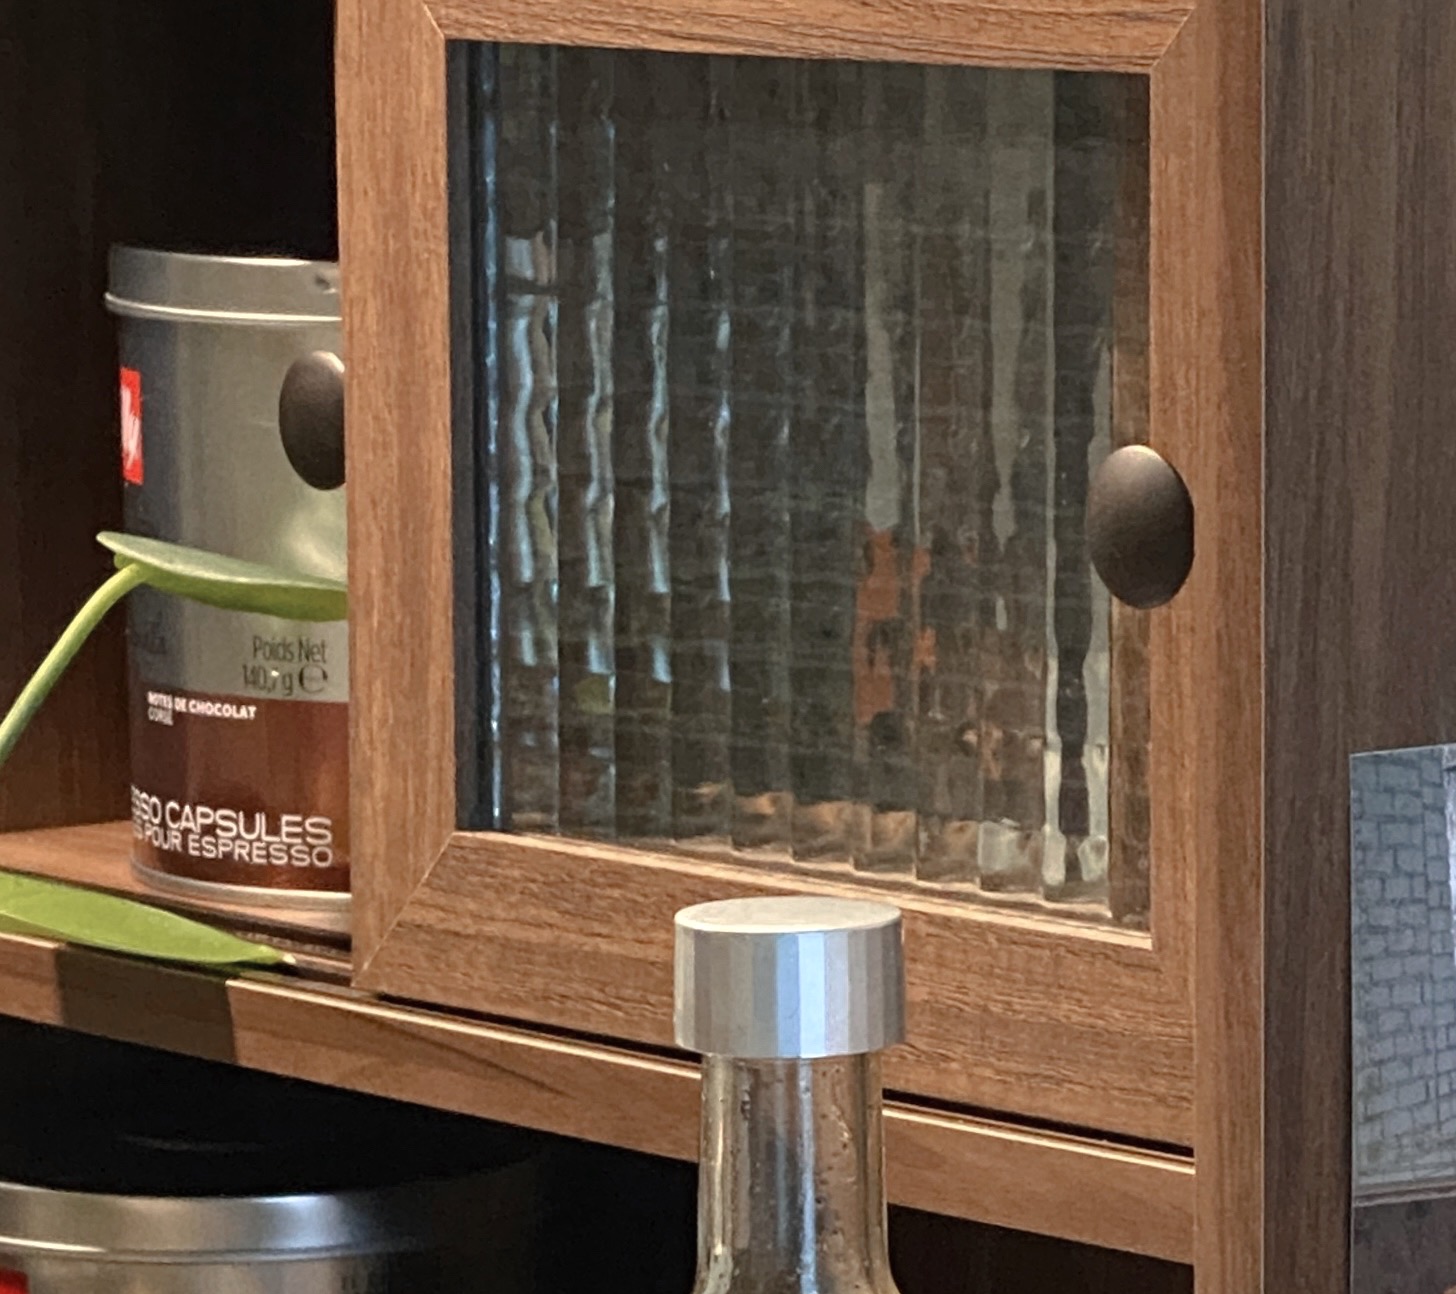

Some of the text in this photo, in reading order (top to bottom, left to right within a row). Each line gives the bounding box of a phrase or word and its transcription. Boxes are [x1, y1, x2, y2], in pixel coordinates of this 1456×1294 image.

[253, 636, 327, 664] Poids Net
[188, 700, 257, 720] CHOCOLAT
[165, 801, 332, 845] CAPSULES
[144, 823, 182, 852] POUR
[188, 834, 333, 868] ESPRESSO
